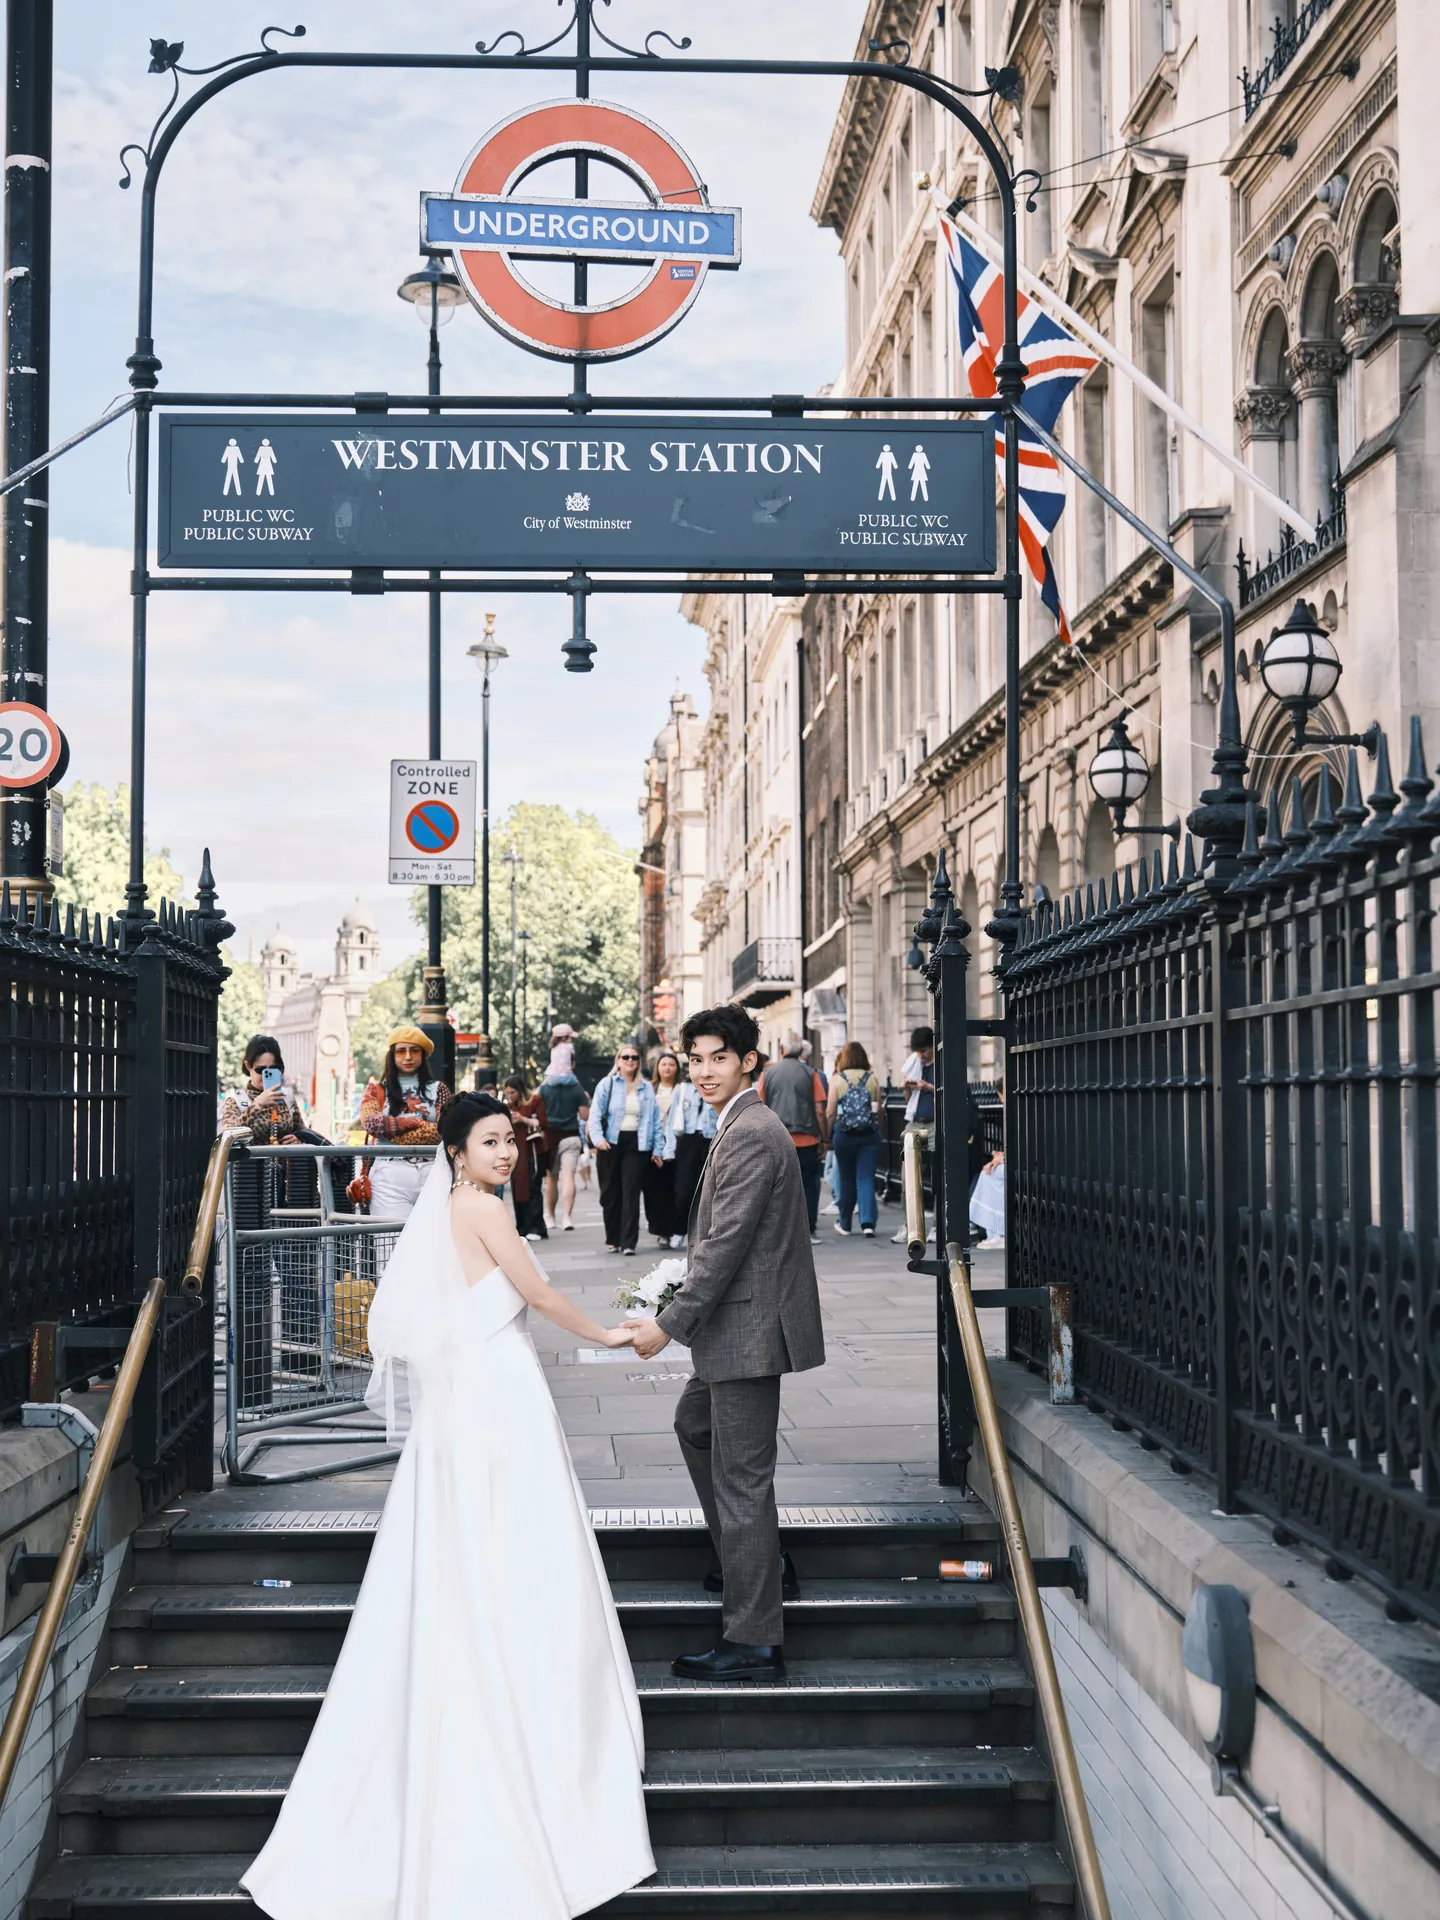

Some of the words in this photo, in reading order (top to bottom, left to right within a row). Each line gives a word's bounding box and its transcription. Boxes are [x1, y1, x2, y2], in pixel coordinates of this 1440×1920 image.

[453, 209, 710, 245] UNDERGROUND
[331, 438, 631, 472] WESTMINSTER
[648, 441, 824, 474] STATION
[202, 509, 263, 522] PUBLIC
[266, 509, 295, 522] WC
[858, 514, 918, 528] PUBLIC
[921, 515, 949, 528] WC
[523, 516, 546, 532] City
[548, 516, 561, 529] of
[563, 517, 632, 530] Westminster
[183, 527, 244, 541] PUBLIC
[247, 527, 314, 541] SUBWAY
[840, 531, 899, 545] PUBLIC
[902, 532, 968, 546] SUBWAY
[397, 765, 471, 778] Controlled
[407, 781, 459, 795] ZONE
[437, 863, 452, 871] Sat
